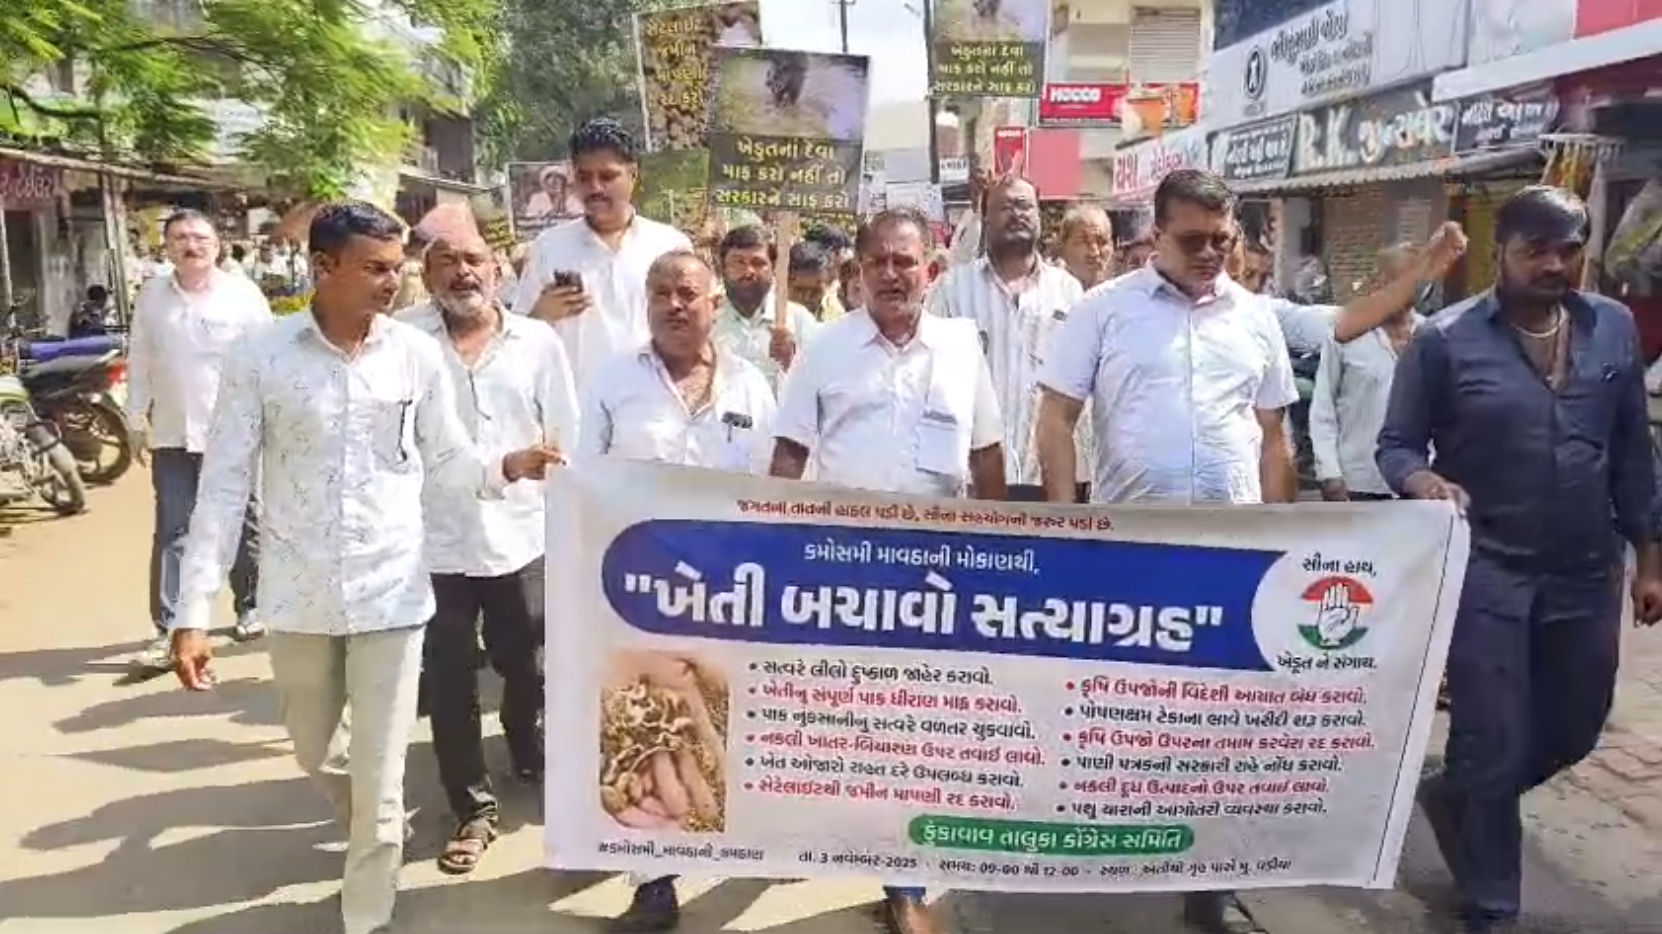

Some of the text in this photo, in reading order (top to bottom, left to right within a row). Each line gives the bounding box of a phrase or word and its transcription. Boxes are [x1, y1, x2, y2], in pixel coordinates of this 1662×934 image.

[722, 164, 750, 181] માફ
[758, 162, 784, 181] કરો
[826, 164, 846, 184] તો
[715, 188, 849, 209] સરકારને સાફ કરો
[875, 503, 898, 519] પડી
[804, 537, 871, 563] કમોસમી
[877, 544, 951, 567] માવઠાની
[1302, 551, 1377, 577] સૌના હાથ,
[624, 561, 1225, 652] "ખેતી બચાવો સત્યાગ્રહ"
[763, 659, 993, 686] સત્વરે લીલો દુષ્કાળ જાહેર કરાવો.
[812, 686, 854, 707] સંપૂર્ણ
[859, 691, 885, 706] પાક
[891, 689, 938, 708] ધીરાણ
[943, 694, 970, 710] માફ
[974, 693, 1023, 713] કરાવો.
[1080, 675, 1110, 698] કૃષિ
[1181, 681, 1229, 701] વિદેશી
[1234, 689, 1285, 703] આયાત
[762, 708, 788, 721] પાક
[872, 714, 916, 733] સત્વરે
[920, 720, 967, 736] વળતર
[972, 720, 1035, 741] ચુકવાવો.
[1079, 700, 1152, 722] પોષણક્ષમ
[1156, 705, 1201, 725] ટેકાના
[1206, 708, 1240, 726] ભાવે
[1244, 709, 1288, 728] ખરીદી
[1321, 709, 1366, 728] કરાવો.
[761, 730, 803, 747] નકલી
[808, 734, 917, 756] ખાતર-બિયારણ
[921, 741, 956, 759] ઉપર
[1005, 745, 1045, 765] લાવો.
[1078, 727, 1374, 750] કૃષિ ઉપજો ઉપરના તમામ કરવેરા રદ કરાવો.
[760, 753, 1024, 787] ખેત ઓજારો રાહત દરે ઉપલબ્ધ કરાવો.
[1077, 753, 1114, 771] પાણી
[1118, 755, 1171, 773] પત્રકની
[1176, 756, 1230, 773] સરકારી
[1298, 755, 1343, 772] કરાવો.
[845, 781, 888, 800] જમીન
[894, 787, 942, 804] માપણી
[946, 792, 964, 806] રદ
[969, 792, 1016, 810] કરાવો.
[1074, 776, 1117, 793] નકલી
[1212, 779, 1245, 795] ઉપર
[1292, 777, 1330, 793] લાવો.
[1072, 797, 1327, 820] પશુ ચારાની આગોતરી વ્યવસ્થા કરાવો.
[999, 829, 1057, 852] તાલુકા
[1121, 828, 1182, 849] સમિતિ
[820, 852, 828, 864] 3
[980, 861, 1020, 876] 09-00
